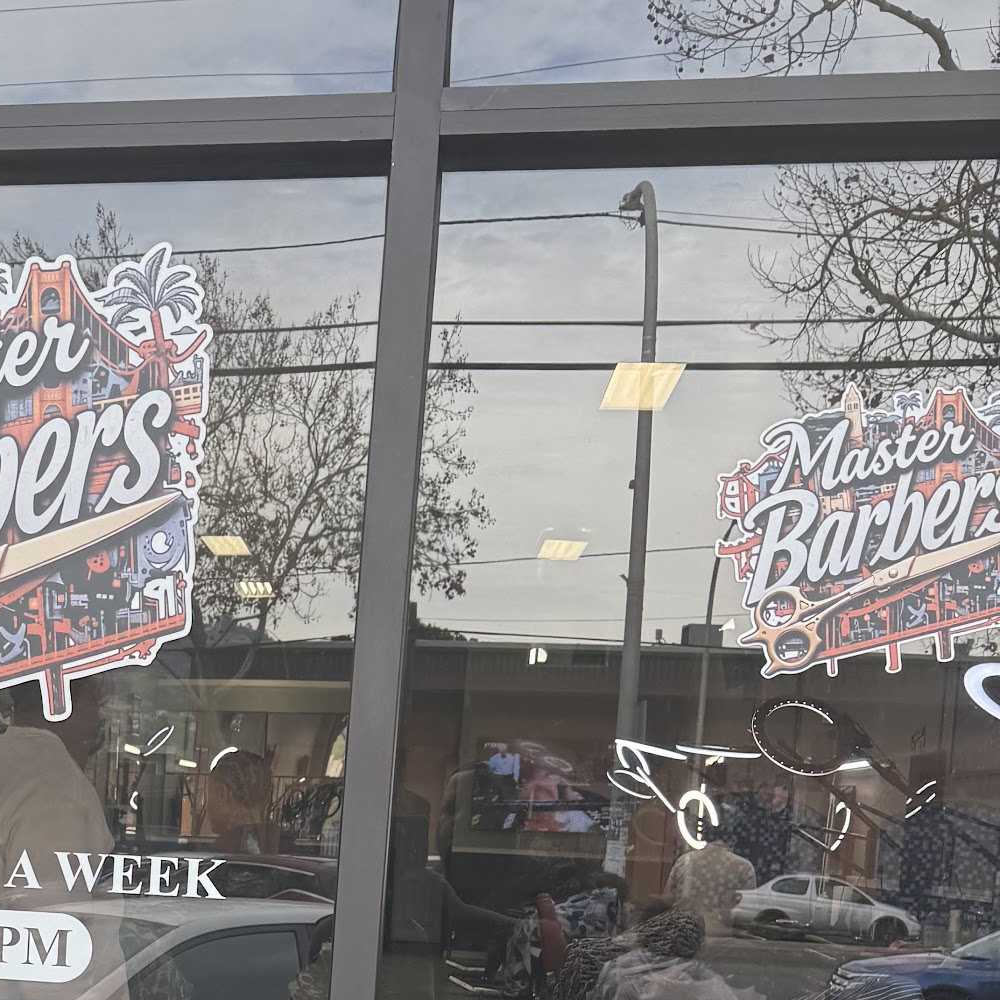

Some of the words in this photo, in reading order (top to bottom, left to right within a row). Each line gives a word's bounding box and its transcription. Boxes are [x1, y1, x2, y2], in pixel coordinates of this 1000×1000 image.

[763, 419, 975, 495] Master
[3, 849, 43, 889] A
[53, 852, 227, 899] WEEK
